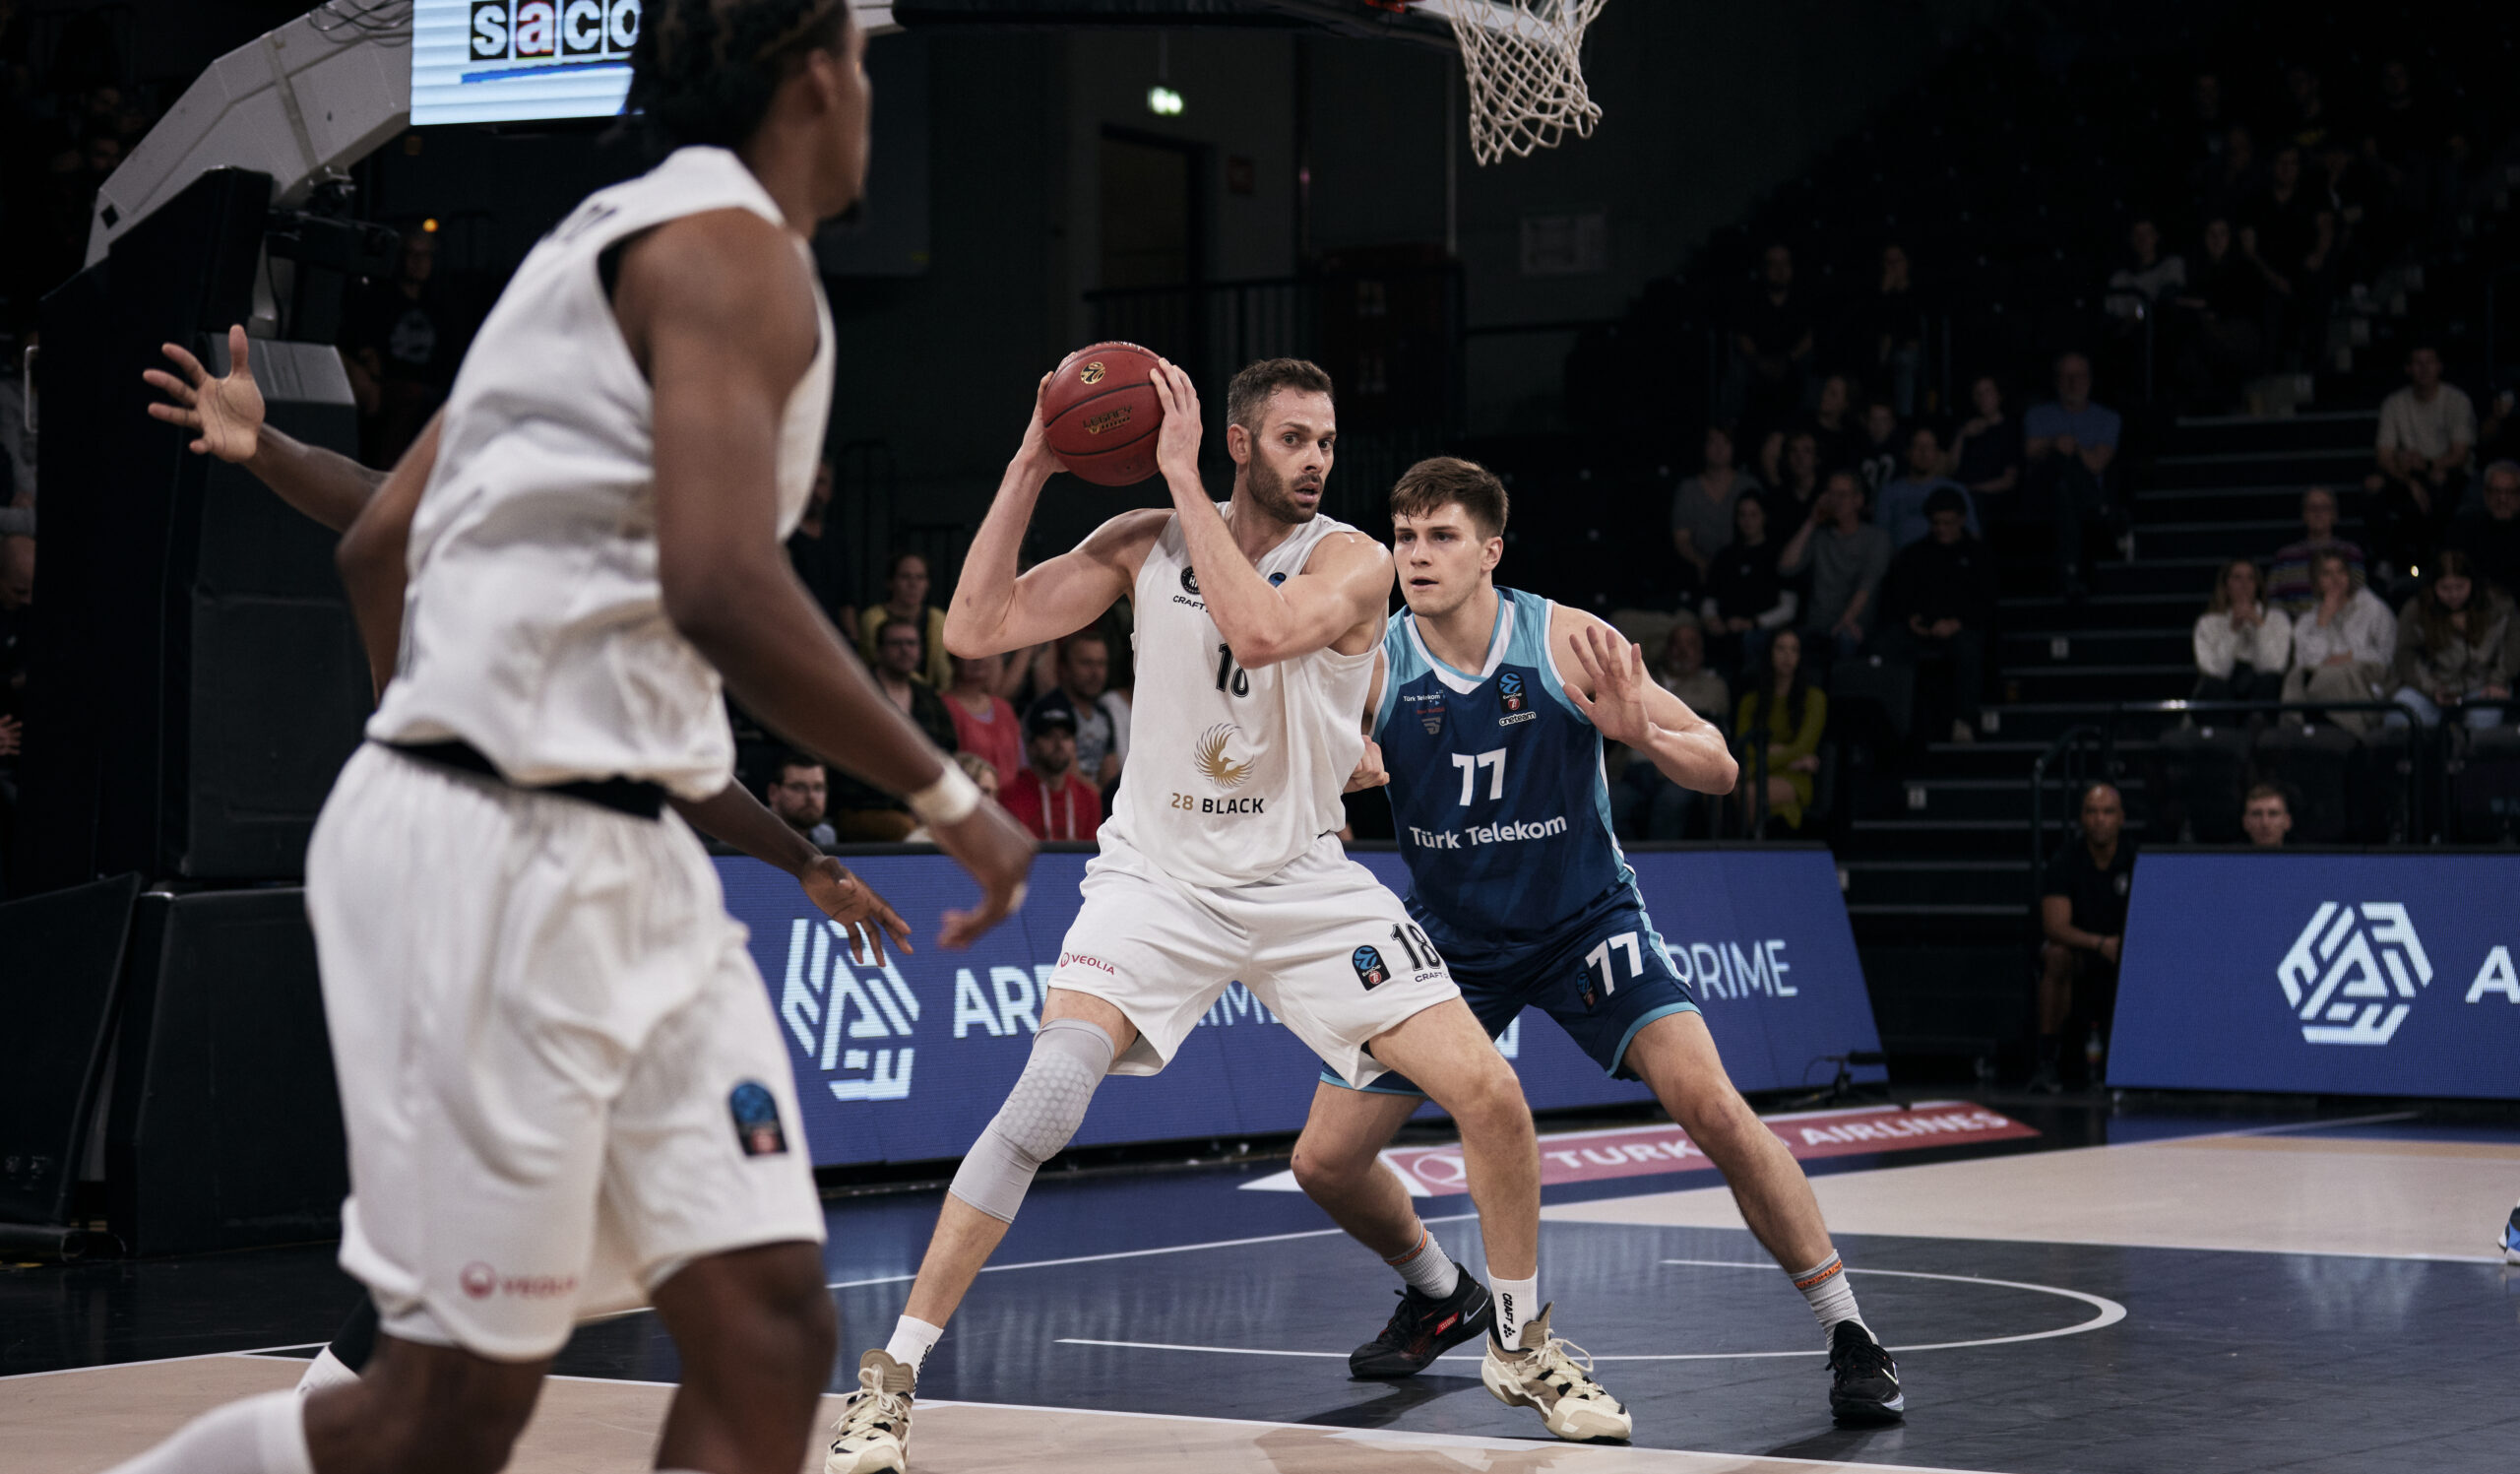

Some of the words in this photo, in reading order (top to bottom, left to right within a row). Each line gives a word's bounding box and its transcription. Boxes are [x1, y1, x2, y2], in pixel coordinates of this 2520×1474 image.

[472, 0, 643, 56] saco
[1172, 595, 1206, 610] CRAFT
[1499, 711, 1537, 727] oneteam
[1451, 746, 1507, 806] 77
[1170, 792, 1194, 811] 28
[1202, 798, 1265, 814] BLACK
[1409, 825, 1463, 850] Türk
[1465, 815, 1568, 847] Telekom
[1390, 923, 1441, 972] 18
[1584, 930, 1644, 997] 77
[1071, 954, 1115, 976] VEOLIA
[1415, 971, 1444, 983] CRAFT
[1799, 1111, 2010, 1147] AIRLINES
[1502, 1292, 1514, 1324] CRAFT
